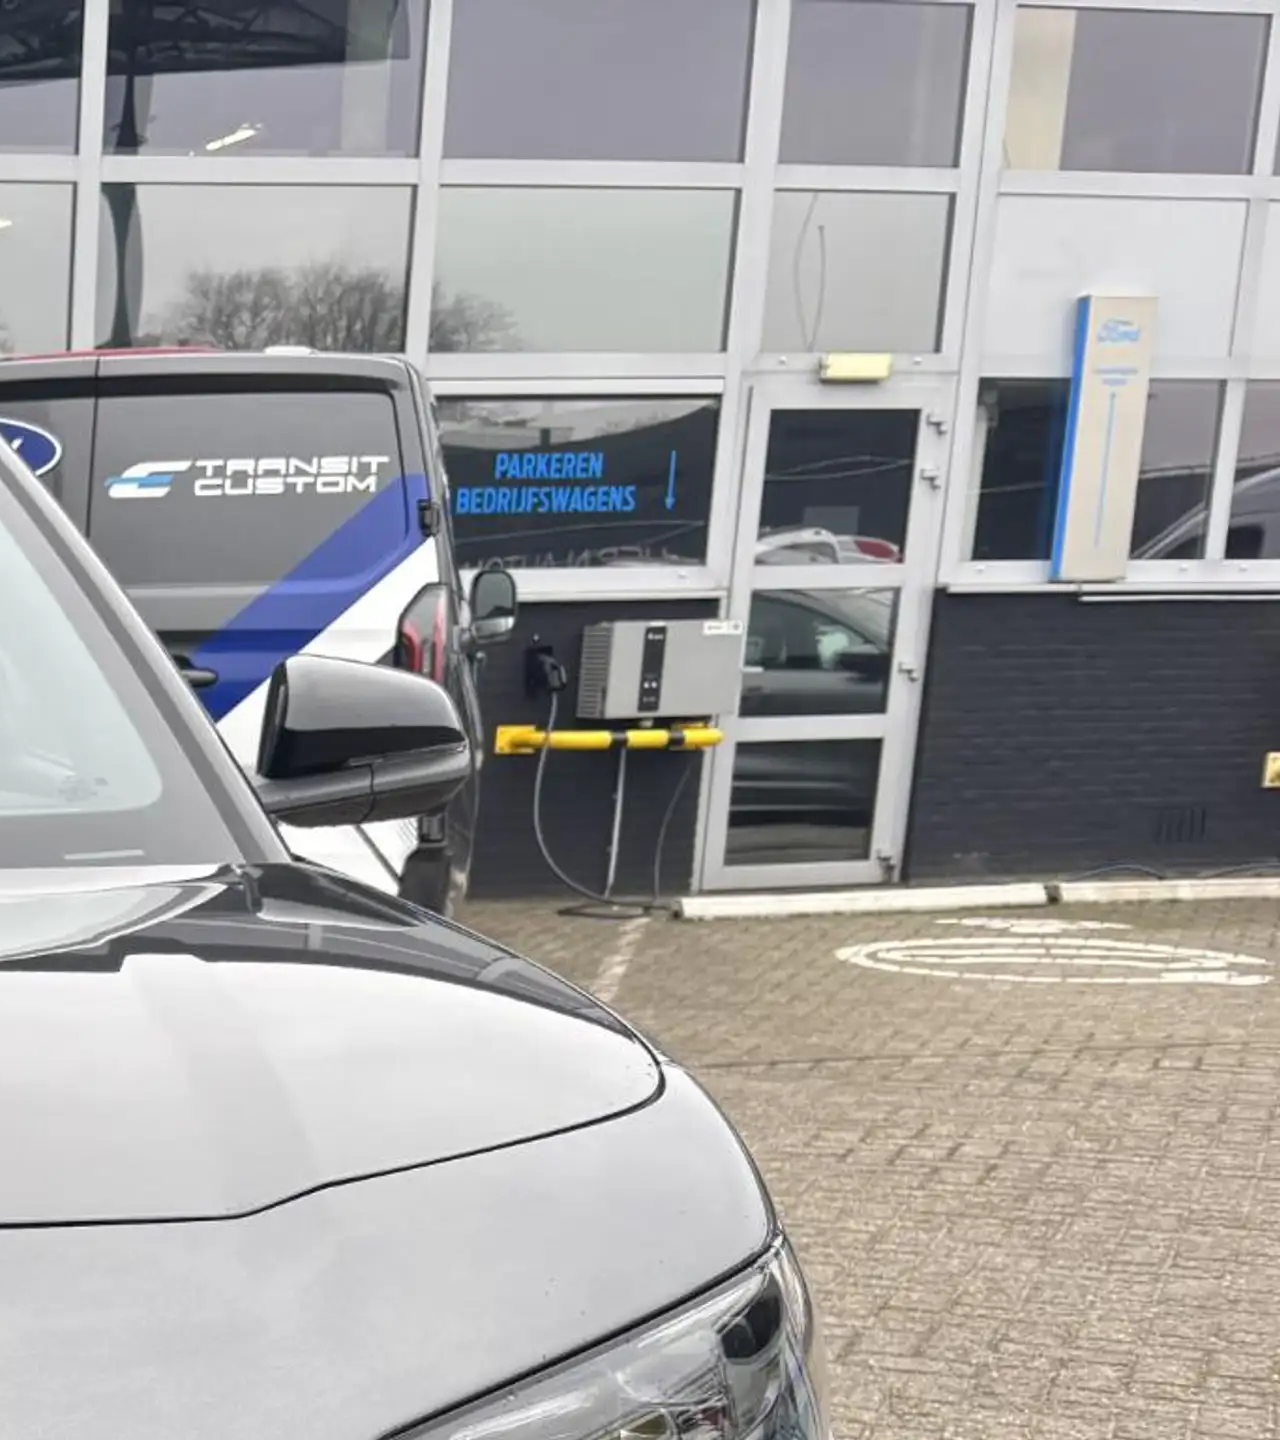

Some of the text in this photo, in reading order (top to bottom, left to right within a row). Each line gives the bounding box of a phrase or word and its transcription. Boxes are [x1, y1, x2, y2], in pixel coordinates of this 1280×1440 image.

[195, 456, 390, 477] TRANSIT
[495, 451, 604, 480] PARKEREN
[194, 476, 376, 496] CUSTOM
[456, 485, 636, 515] BEDRIJFSWAGENS
